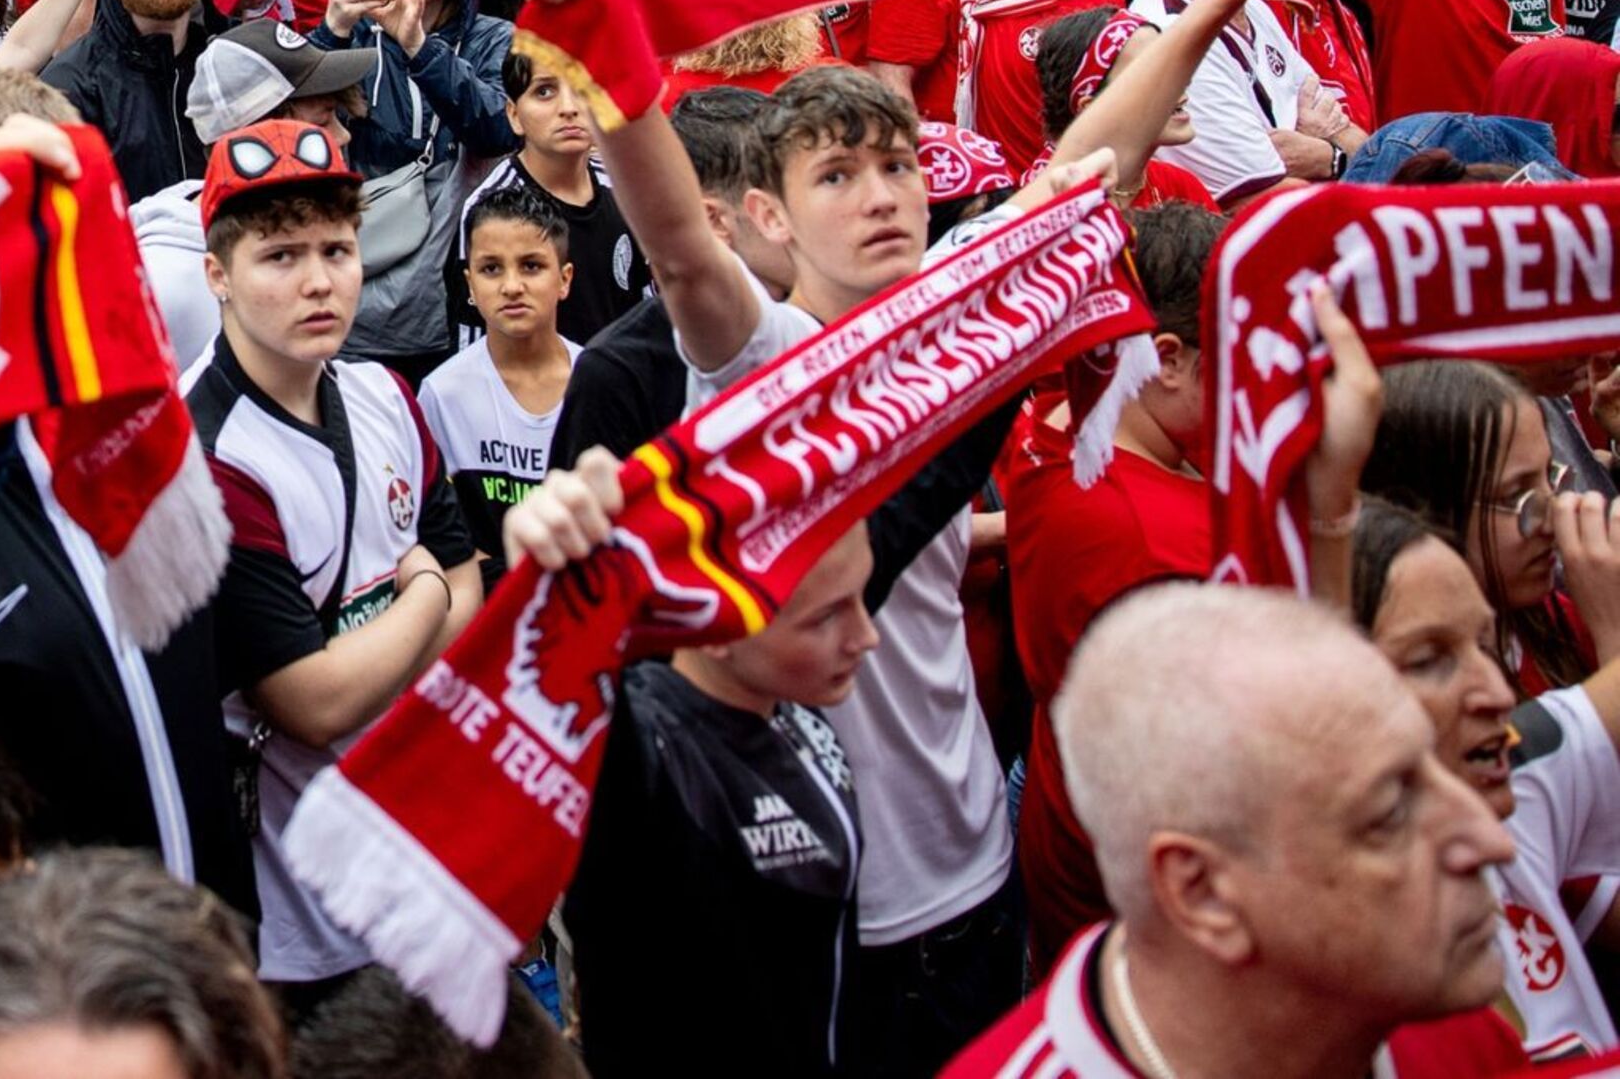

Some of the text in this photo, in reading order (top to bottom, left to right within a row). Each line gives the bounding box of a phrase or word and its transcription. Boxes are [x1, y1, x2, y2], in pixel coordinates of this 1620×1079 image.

[801, 327, 868, 382] ROTEN
[873, 284, 945, 332] TEUFEL
[947, 257, 988, 293] VOM
[480, 438, 544, 472] ACTIVE
[414, 658, 501, 743] ROTE
